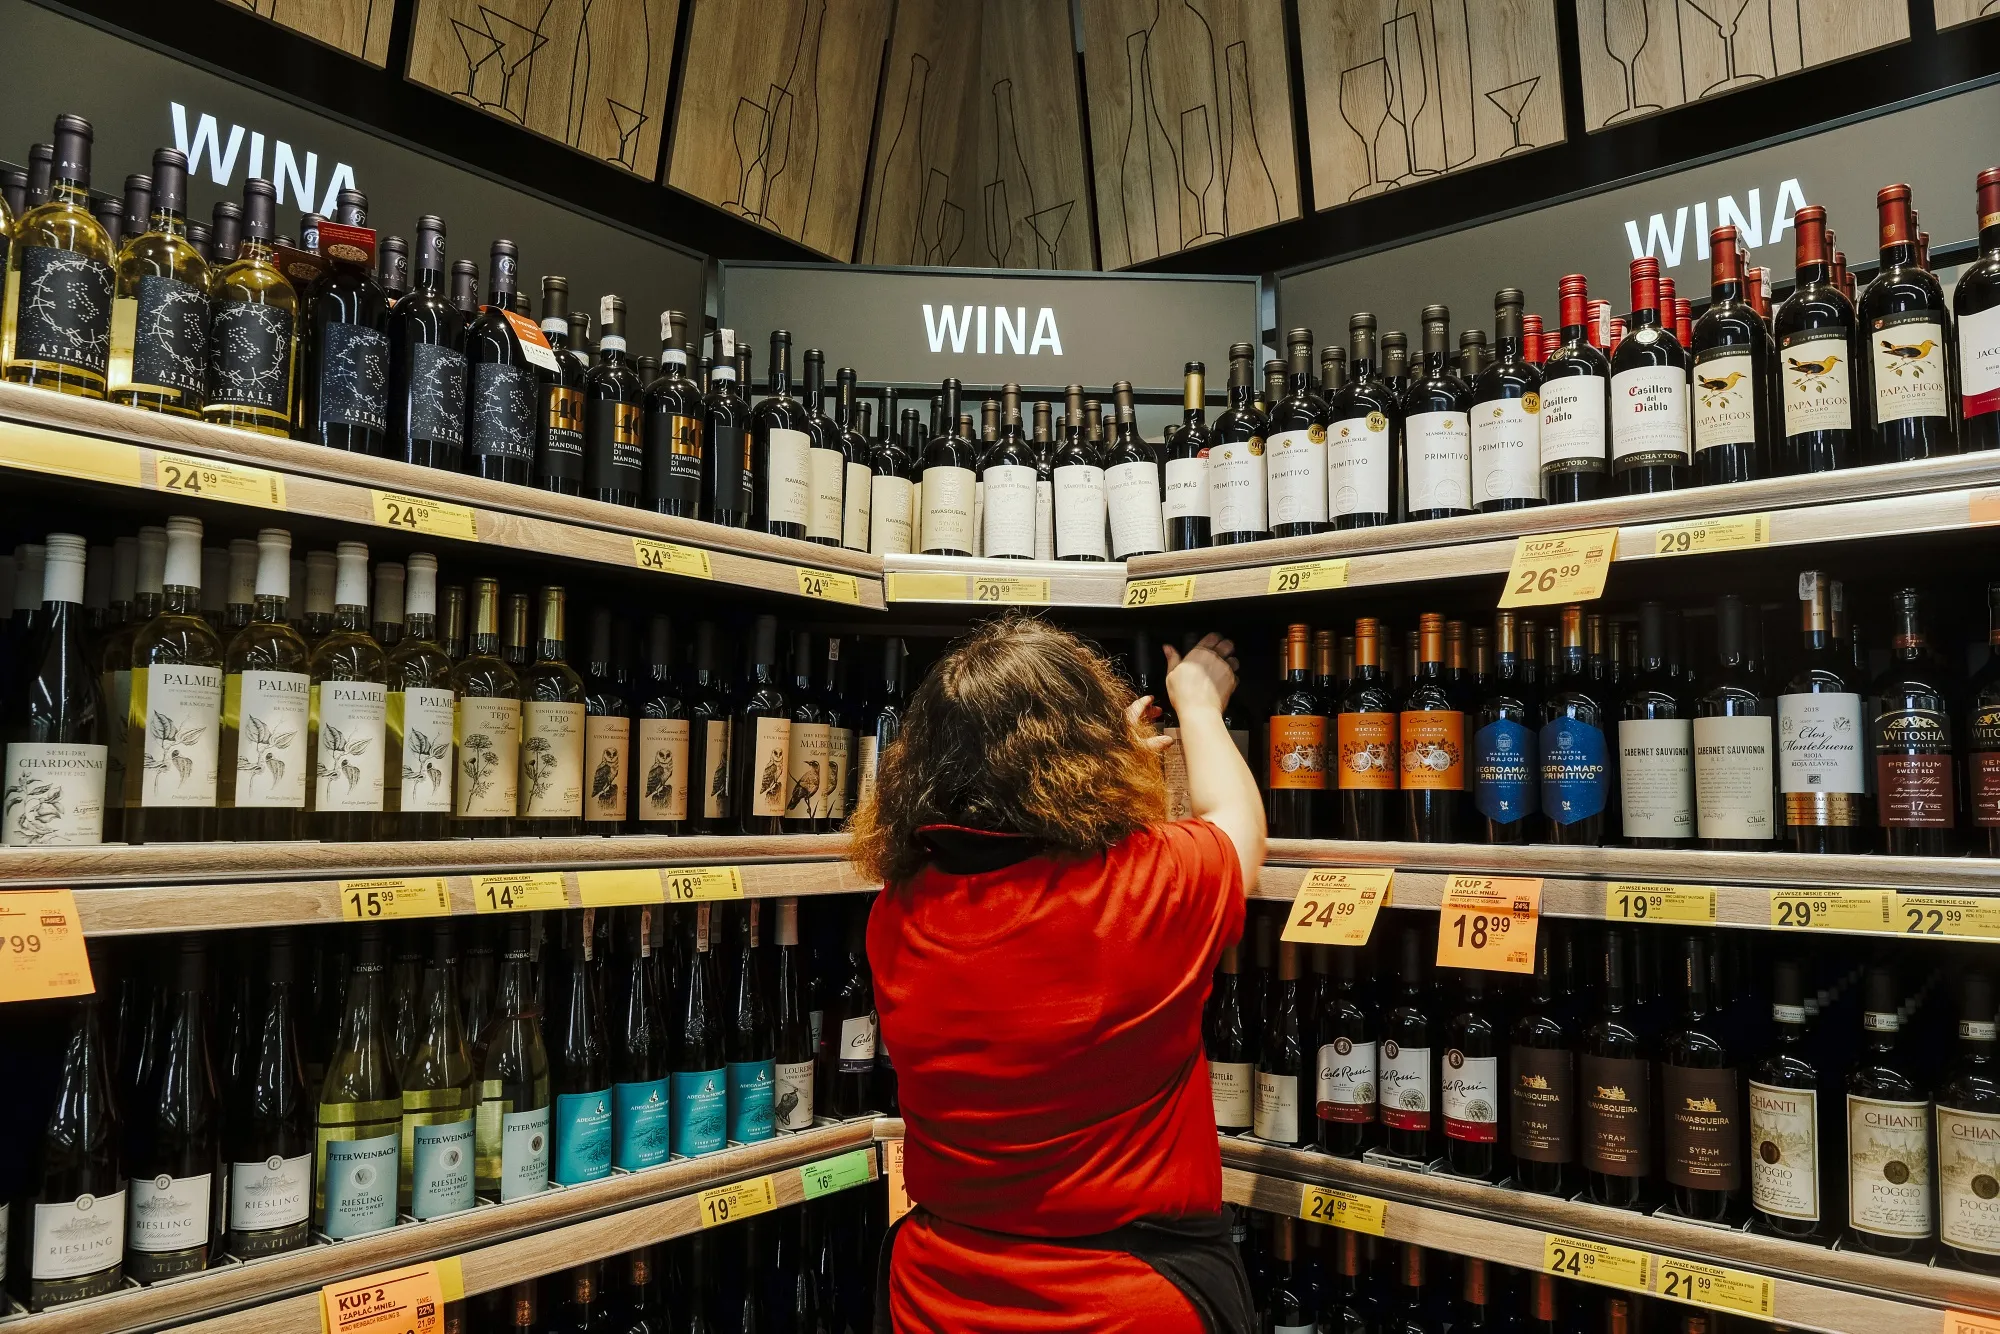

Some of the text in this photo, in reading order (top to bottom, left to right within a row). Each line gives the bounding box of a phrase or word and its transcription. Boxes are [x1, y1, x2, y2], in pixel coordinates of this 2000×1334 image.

[171, 101, 356, 219] WINA
[1624, 178, 1807, 268] WINA
[923, 305, 1063, 355] WINA
[39, 344, 105, 369] ASTRALE
[212, 389, 273, 402] ASTRALE
[1629, 385, 1672, 396] Casillero
[1880, 382, 1944, 398] PAPA FIGOS
[1901, 392, 1926, 400] DOURO
[1525, 397, 1537, 407] 96
[1543, 396, 1578, 410] Casillero
[1635, 403, 1668, 413] Diablo
[1787, 397, 1847, 413] PAPA FIGOS
[1804, 406, 1829, 414] DOURO
[1371, 417, 1383, 426] 96
[1545, 413, 1572, 425] Diablo
[1696, 411, 1751, 427] PAPA FIGOS
[549, 429, 582, 440] PRIMITIVO
[1479, 441, 1524, 452] PRIMITIVO
[1425, 452, 1468, 461] PRIMITIVO
[1624, 454, 1656, 463] CONCHA
[1331, 458, 1368, 470] PRIMITIVO
[165, 466, 201, 492] 24
[203, 472, 217, 483] 99
[1272, 469, 1310, 480] PRIMITIVO
[1214, 480, 1249, 490] PRIMITIVO
[387, 503, 416, 528] 24
[417, 508, 428, 518] 99
[1525, 542, 1553, 551] KUP
[1660, 531, 1691, 554] 29
[1693, 529, 1706, 539] 99
[640, 547, 663, 569] 34
[1278, 573, 1299, 590] 29
[1515, 568, 1557, 594] 26
[1560, 565, 1580, 578] 99
[804, 577, 823, 597] 24
[978, 584, 1000, 602] 29
[1127, 588, 1148, 606] 29
[490, 712, 509, 720] TEJO
[550, 716, 568, 724] TEJO
[1799, 726, 1825, 739] Clos
[1883, 730, 1945, 741] WITOSHA
[1781, 735, 1854, 752] Montebuena
[1624, 748, 1688, 757] CABERNET SAUVIGNON
[19, 759, 103, 769] CHARDONNAY
[1544, 772, 1594, 780] PRIMITIVO
[1911, 801, 1924, 810] 17
[672, 878, 693, 899] 18
[692, 877, 701, 886] 99
[1455, 880, 1492, 889] KUP 2
[350, 892, 381, 917] 15
[382, 891, 394, 901] 99
[486, 886, 514, 910] 14
[513, 885, 524, 895] 99
[1620, 895, 1662, 918] 19 99
[1777, 901, 1827, 926] 29 99
[1297, 901, 1355, 927] 24 99
[1906, 909, 1943, 934] 22
[1946, 910, 1961, 922] 99
[1454, 915, 1488, 949] 18
[1491, 917, 1511, 933] 99
[11, 935, 41, 953] 99
[1320, 1064, 1372, 1082] Carlo Rossi
[1391, 1069, 1422, 1087] Rossi
[1454, 1080, 1488, 1098] Rossi
[1751, 1094, 1797, 1113] CHIANTI
[1675, 1114, 1729, 1124] RAVASQUEIRA
[1865, 1112, 1922, 1128] CHIANTI
[507, 1124, 530, 1133] PETER
[417, 1137, 442, 1145] PETER
[329, 1146, 396, 1161] PETER WEINBACH
[1689, 1147, 1719, 1155] SYRAH
[1754, 1163, 1793, 1179] POGGIO
[431, 1175, 467, 1188] RIESLING
[817, 1176, 828, 1190] 16
[1767, 1176, 1792, 1187] SALE
[1872, 1184, 1920, 1198] POGGIO
[245, 1194, 300, 1209] RIESLING
[342, 1195, 383, 1207] RIESLING
[1311, 1196, 1334, 1220] 24
[1337, 1201, 1346, 1211] 99
[1893, 1197, 1921, 1205] SALE
[708, 1198, 729, 1222] 19
[136, 1218, 192, 1230] RIESLING
[50, 1236, 112, 1256] RIESLING
[1554, 1237, 1575, 1245] ZAWSZE
[1576, 1241, 1593, 1249] NISKIE
[1552, 1248, 1581, 1275] 24
[1583, 1254, 1595, 1264] 99
[1666, 1260, 1689, 1268] ZAWSZE
[1691, 1264, 1707, 1272] NISKIE
[1664, 1271, 1692, 1300] 21
[1698, 1277, 1711, 1289] 99
[339, 1289, 385, 1311] KUP 2
[343, 1305, 372, 1320] ZAPŁAĆ
[374, 1301, 396, 1313] MNIEJ
[418, 1305, 433, 1315] 22%
[418, 1317, 435, 1328] 21,99
